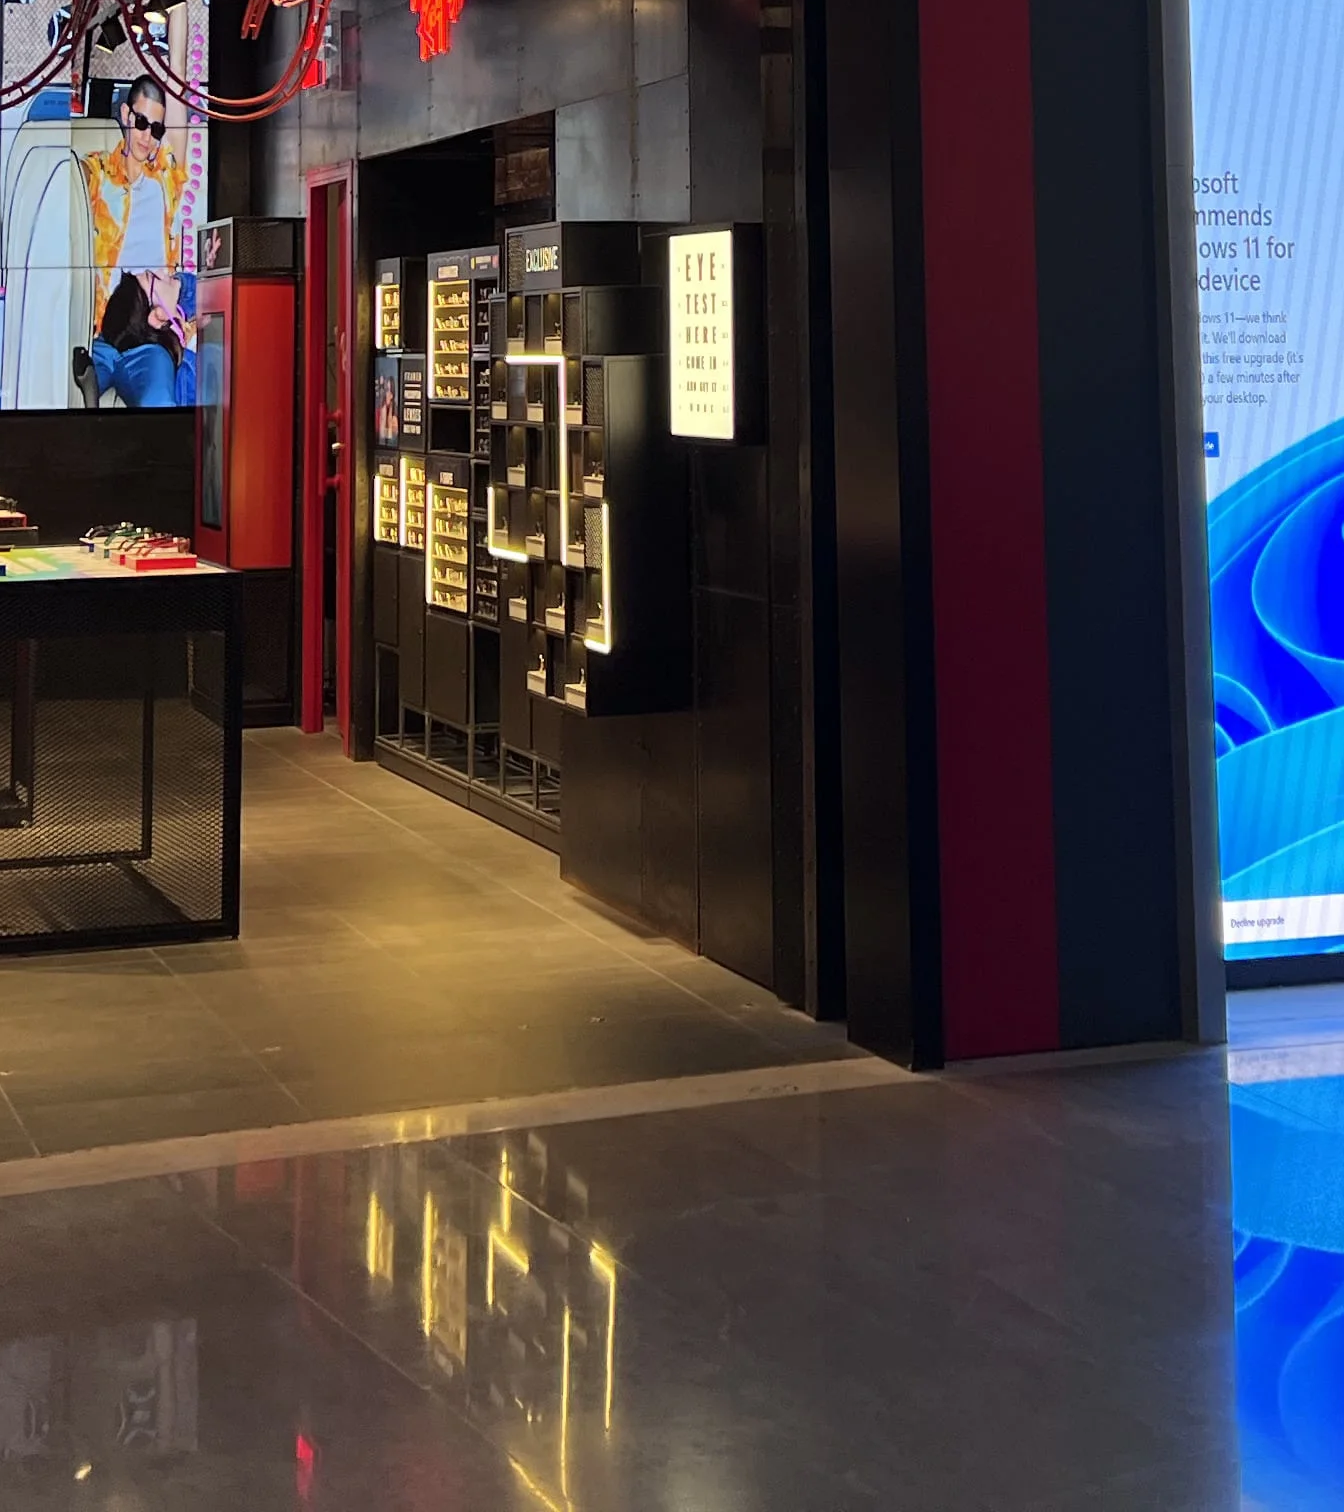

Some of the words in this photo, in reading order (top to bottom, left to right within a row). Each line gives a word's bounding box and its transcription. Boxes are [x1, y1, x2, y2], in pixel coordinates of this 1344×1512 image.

[1243, 236, 1260, 259] 11
[1266, 236, 1295, 259] for
[685, 252, 716, 282] EYE
[1198, 268, 1261, 291] device
[686, 293, 717, 315] TEST
[1263, 312, 1287, 324] think
[686, 326, 717, 345] HERE
[1239, 331, 1287, 344] download
[1203, 352, 1220, 364] this
[1223, 352, 1241, 364] free
[1244, 352, 1285, 367] upgrade
[1216, 372, 1234, 384] few
[1236, 372, 1275, 384] minutes
[1277, 371, 1301, 384] after
[1226, 392, 1268, 407] desktop.
[1257, 916, 1285, 928] upgrade
